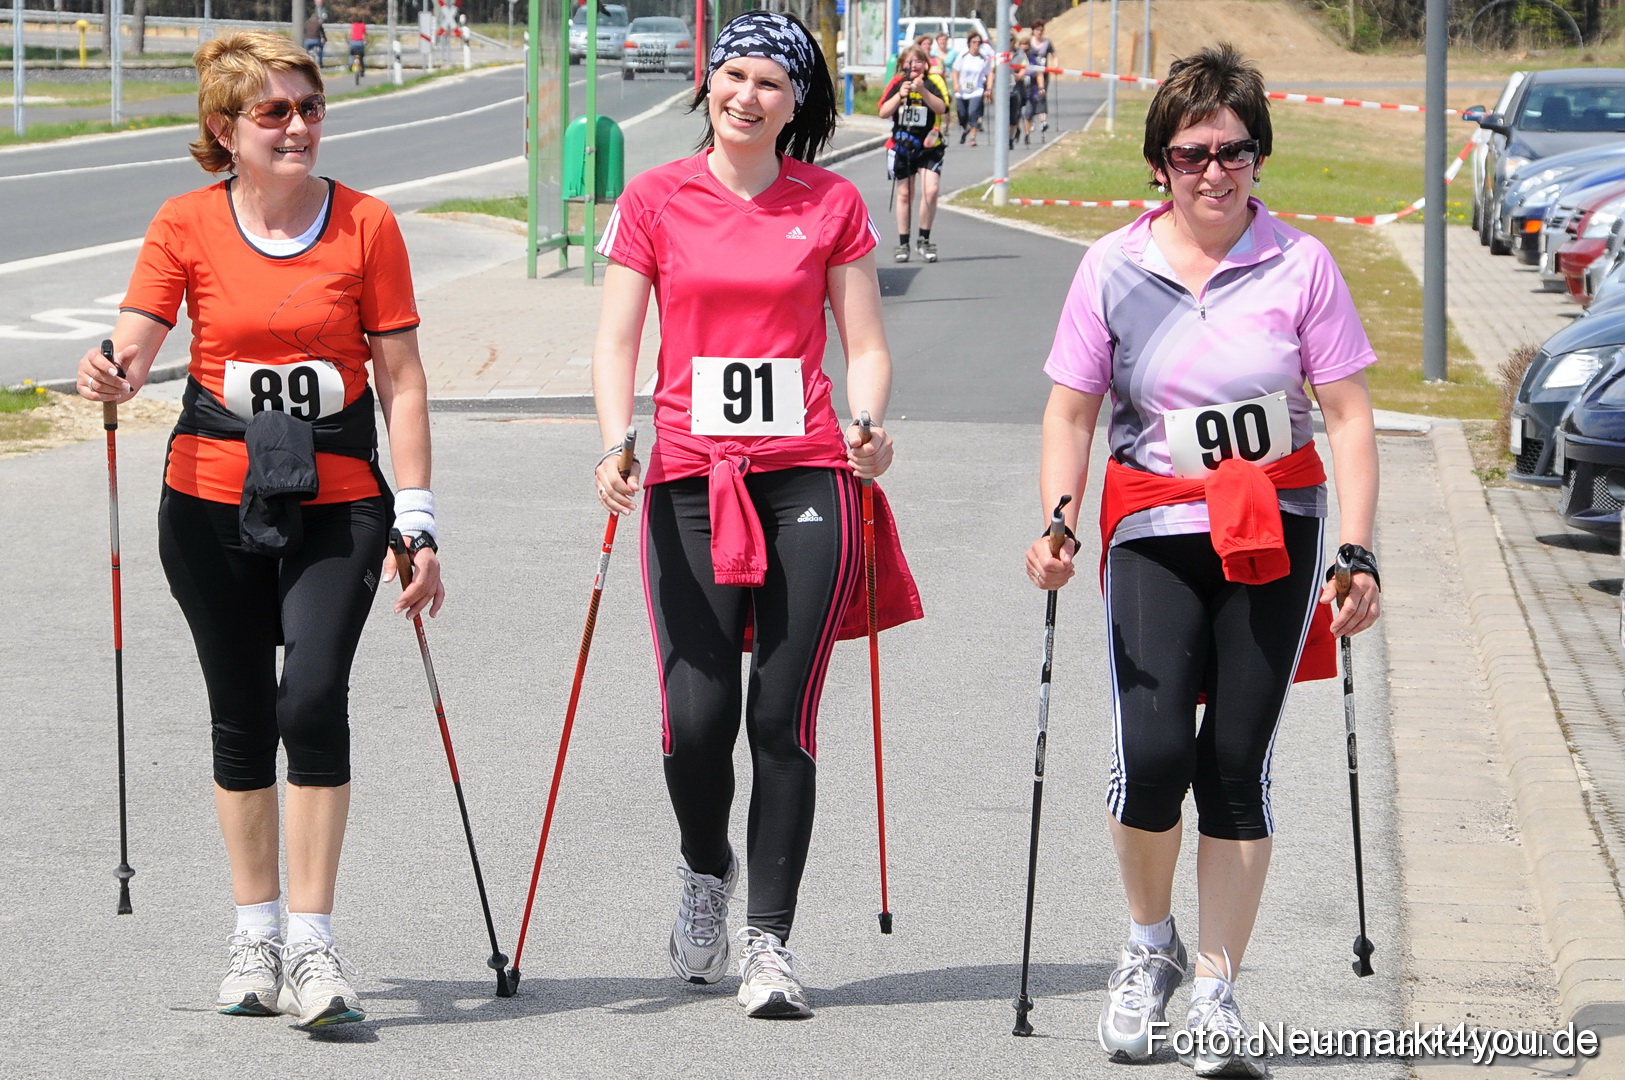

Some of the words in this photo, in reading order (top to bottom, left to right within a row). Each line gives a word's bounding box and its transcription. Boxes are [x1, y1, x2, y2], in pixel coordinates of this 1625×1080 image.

[250, 366, 321, 421] 89
[723, 362, 774, 424] 91
[1196, 404, 1271, 471] 90
